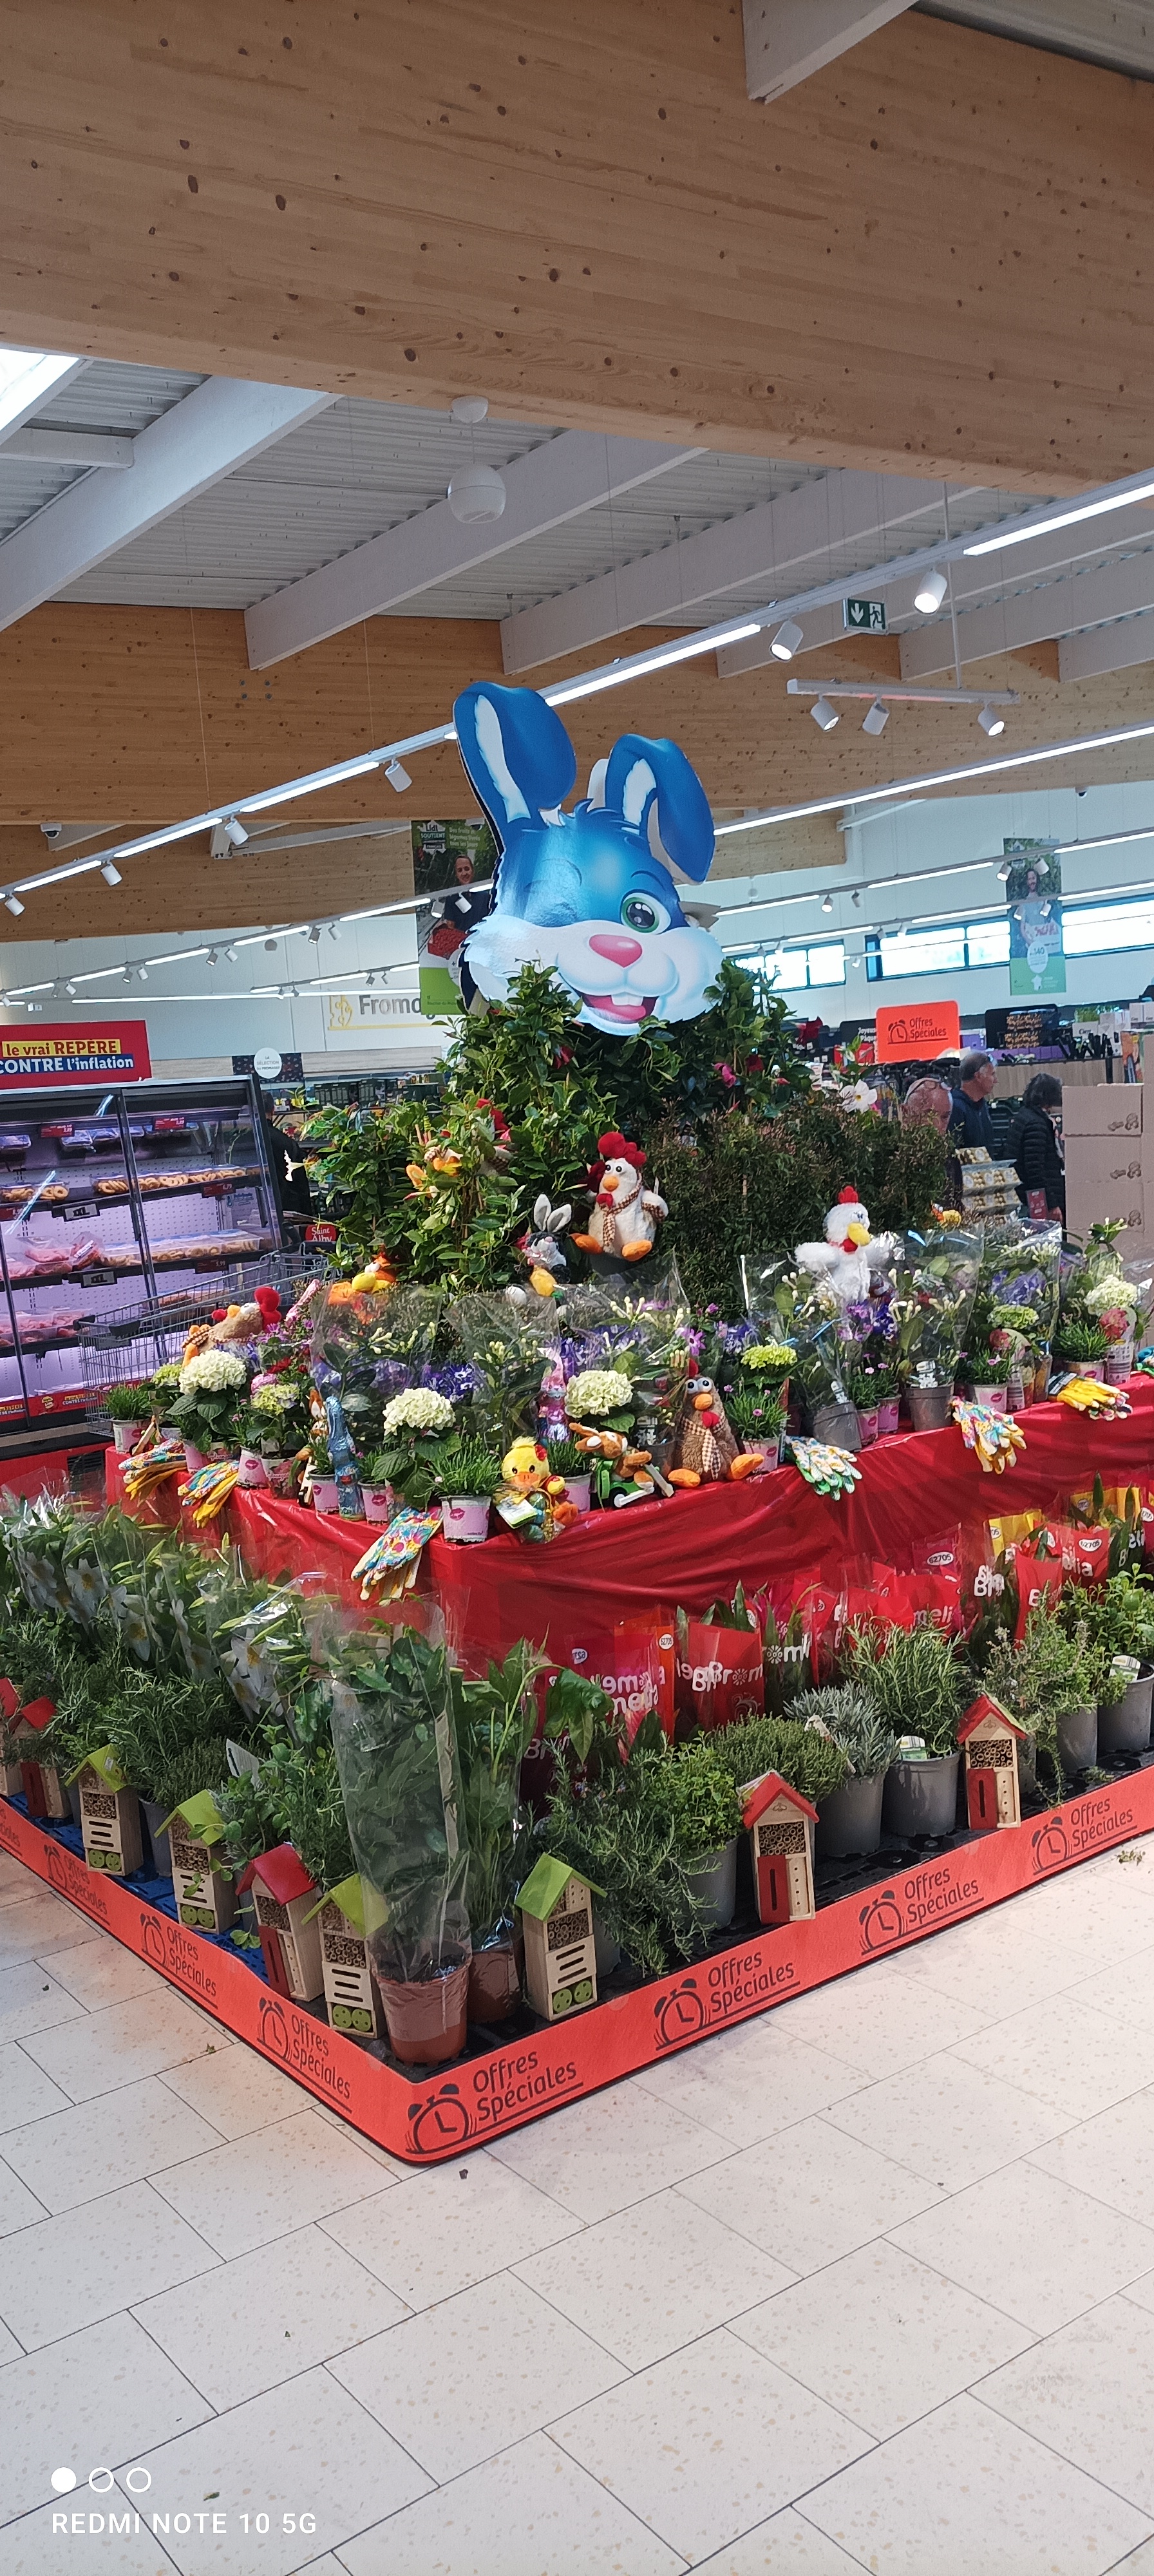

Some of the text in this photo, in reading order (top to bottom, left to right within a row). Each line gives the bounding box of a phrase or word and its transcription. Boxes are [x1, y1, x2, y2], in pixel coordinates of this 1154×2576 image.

[910, 1017, 933, 1030] Offres
[910, 1027, 947, 1041] Spéciales
[6, 1039, 117, 1056] le vrai REPÈRE
[73, 1207, 90, 1217] XXL
[311, 1227, 330, 1235] Saint
[91, 1274, 108, 1283] XXL
[928, 1553, 952, 1564] 62705
[1071, 1798, 1111, 1827] Offres
[1072, 1809, 1133, 1849] Spéciales
[64, 1855, 90, 1885] Offres
[905, 1868, 951, 1900] Offres
[68, 1873, 108, 1915] Spéciales
[907, 1879, 979, 1925] Spéciales
[167, 1926, 198, 1961] Offres
[169, 1947, 216, 1997] Spéciales
[708, 1952, 762, 1988] Offres
[710, 1962, 794, 2014] Spéciales
[291, 2014, 329, 2057] Offres
[293, 2039, 351, 2099] Spéciales
[473, 2051, 538, 2094] Offres
[477, 2061, 577, 2121] Spéciales
